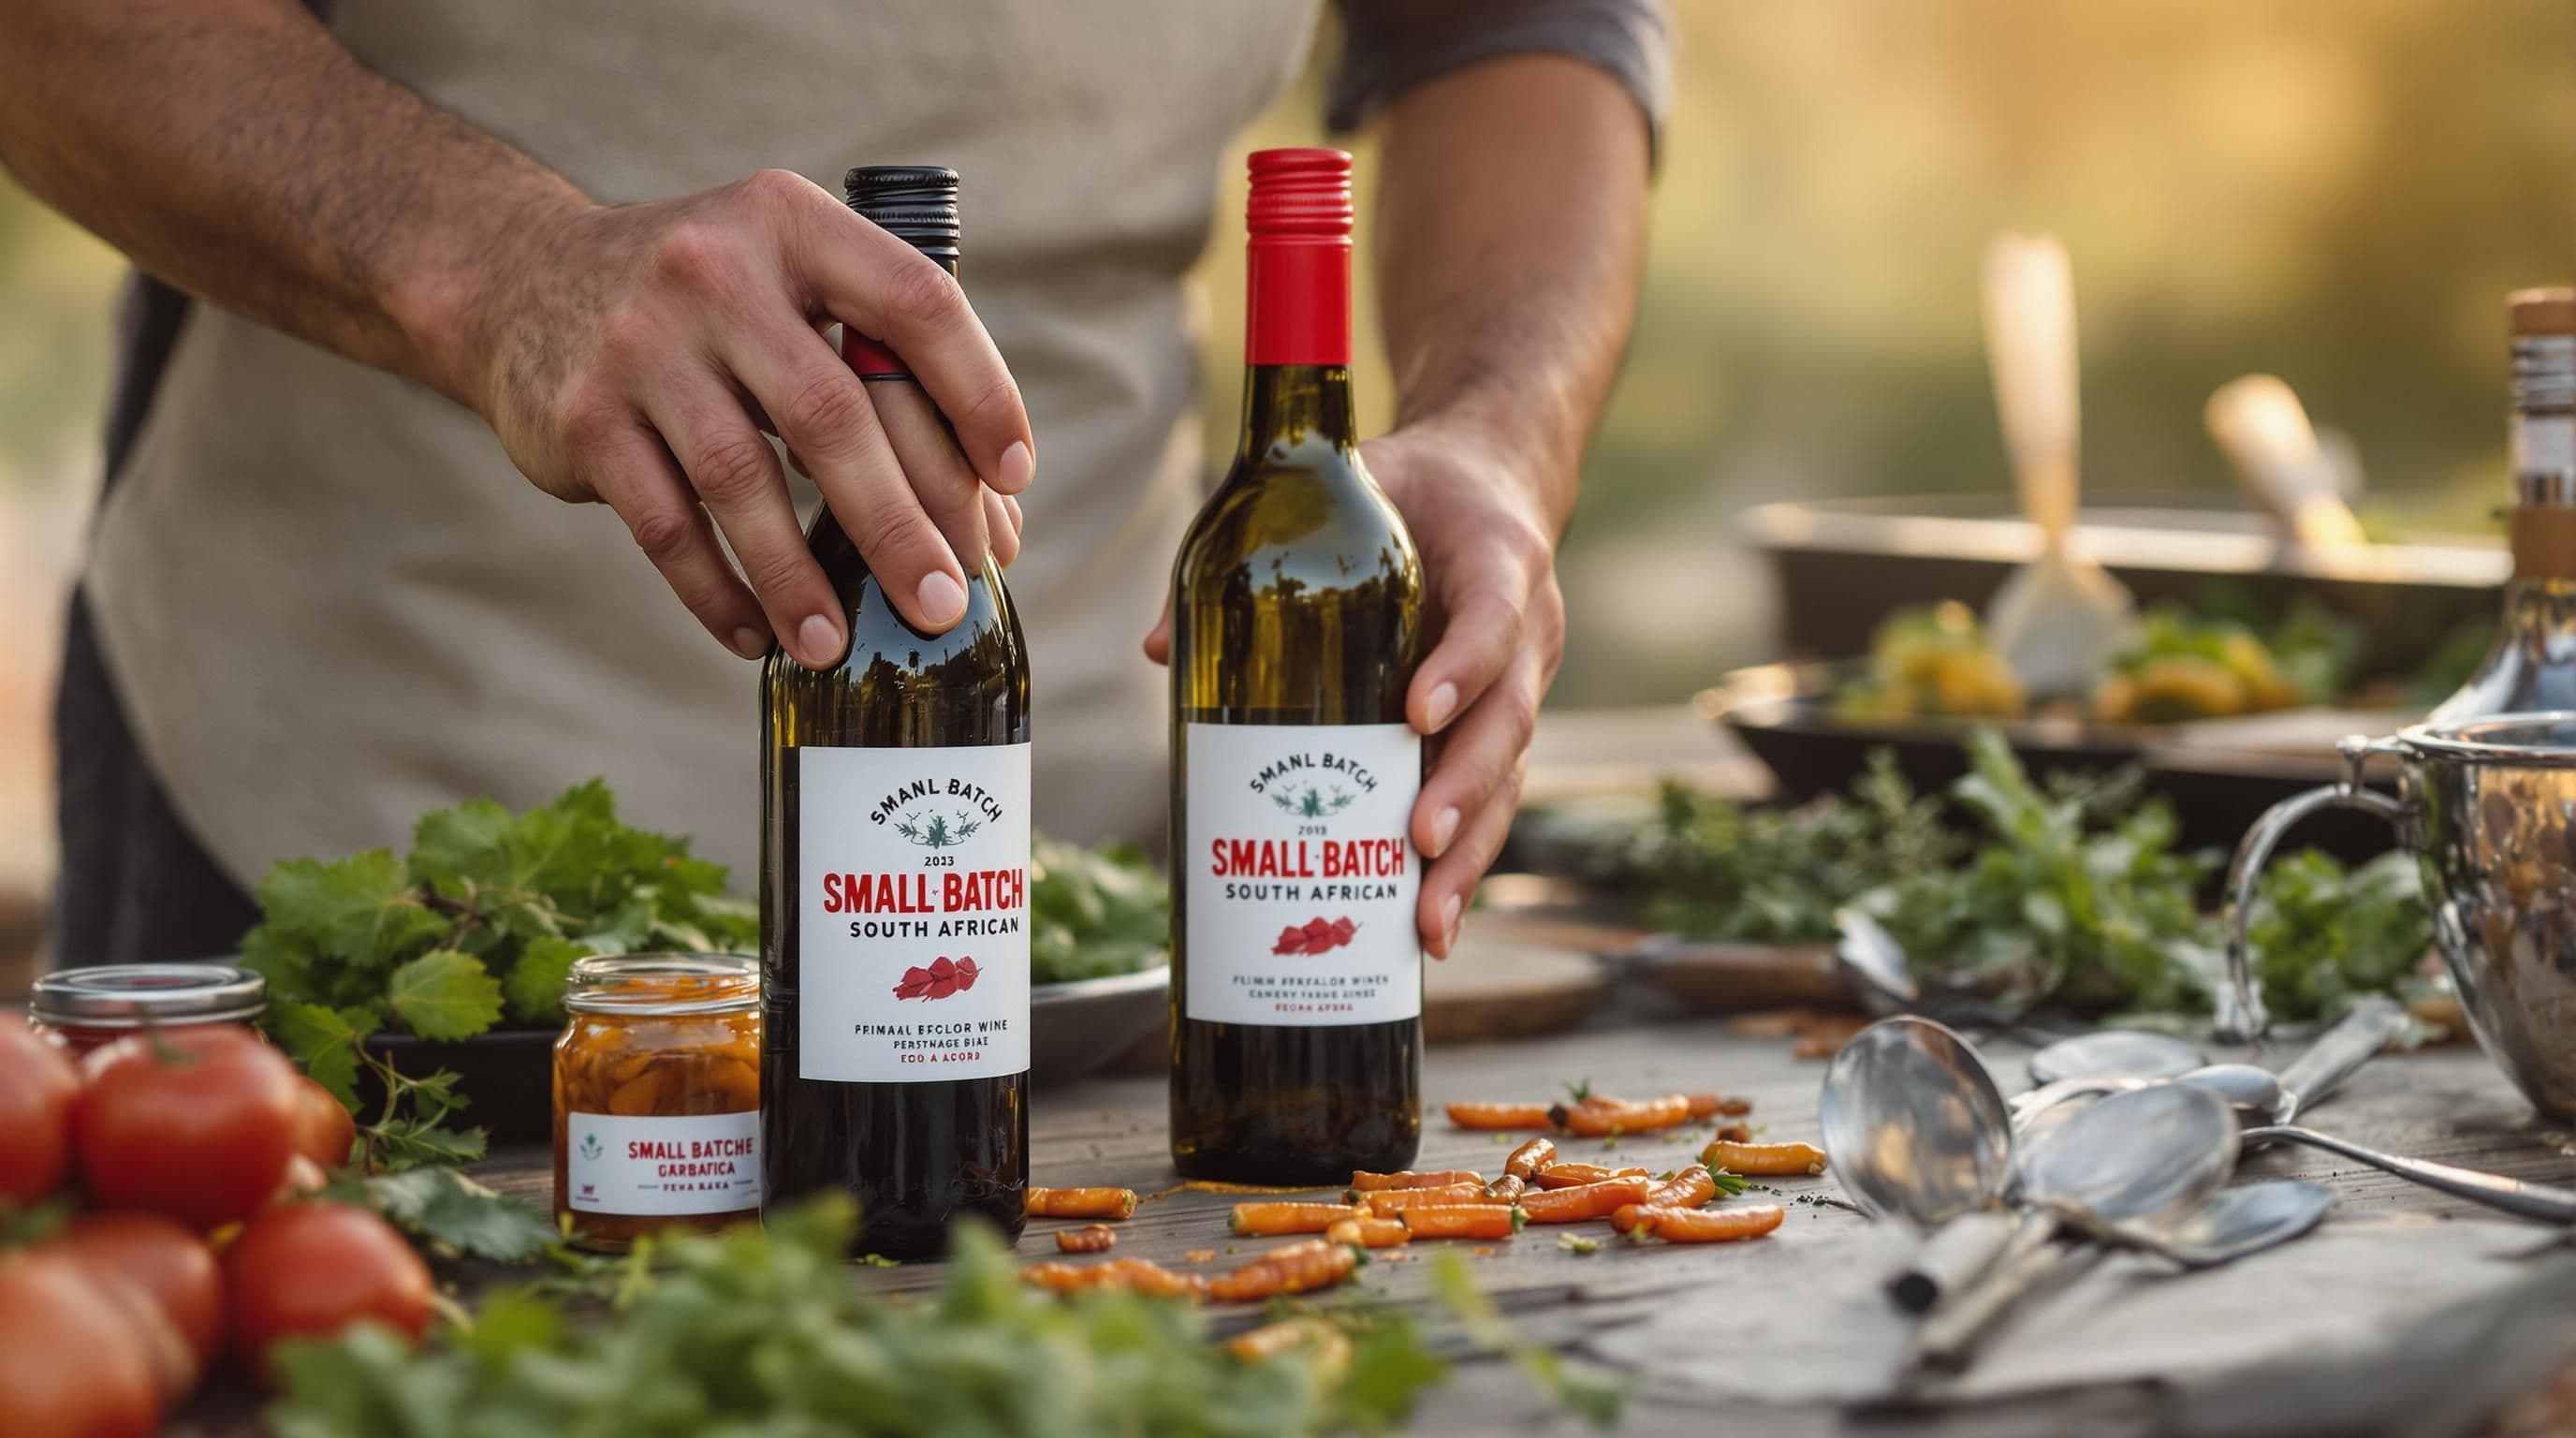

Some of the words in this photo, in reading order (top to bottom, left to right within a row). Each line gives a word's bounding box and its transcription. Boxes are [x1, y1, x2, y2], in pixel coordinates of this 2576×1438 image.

[1323, 753, 1378, 793] BATCH
[947, 778, 1003, 823] BATCH
[1211, 838, 1314, 877] SMALL
[1323, 838, 1404, 877] BATCH
[824, 873, 935, 914] SMALL
[944, 869, 1023, 913] BATCH
[1225, 884, 1299, 902] SOUTH
[1310, 884, 1398, 902] AFRICAN
[850, 921, 929, 938] SOUTH
[938, 917, 1018, 937] AFRICAN
[978, 1020, 1008, 1033] WINE
[628, 1141, 685, 1160] SMALL
[692, 1137, 754, 1158] BATCHE
